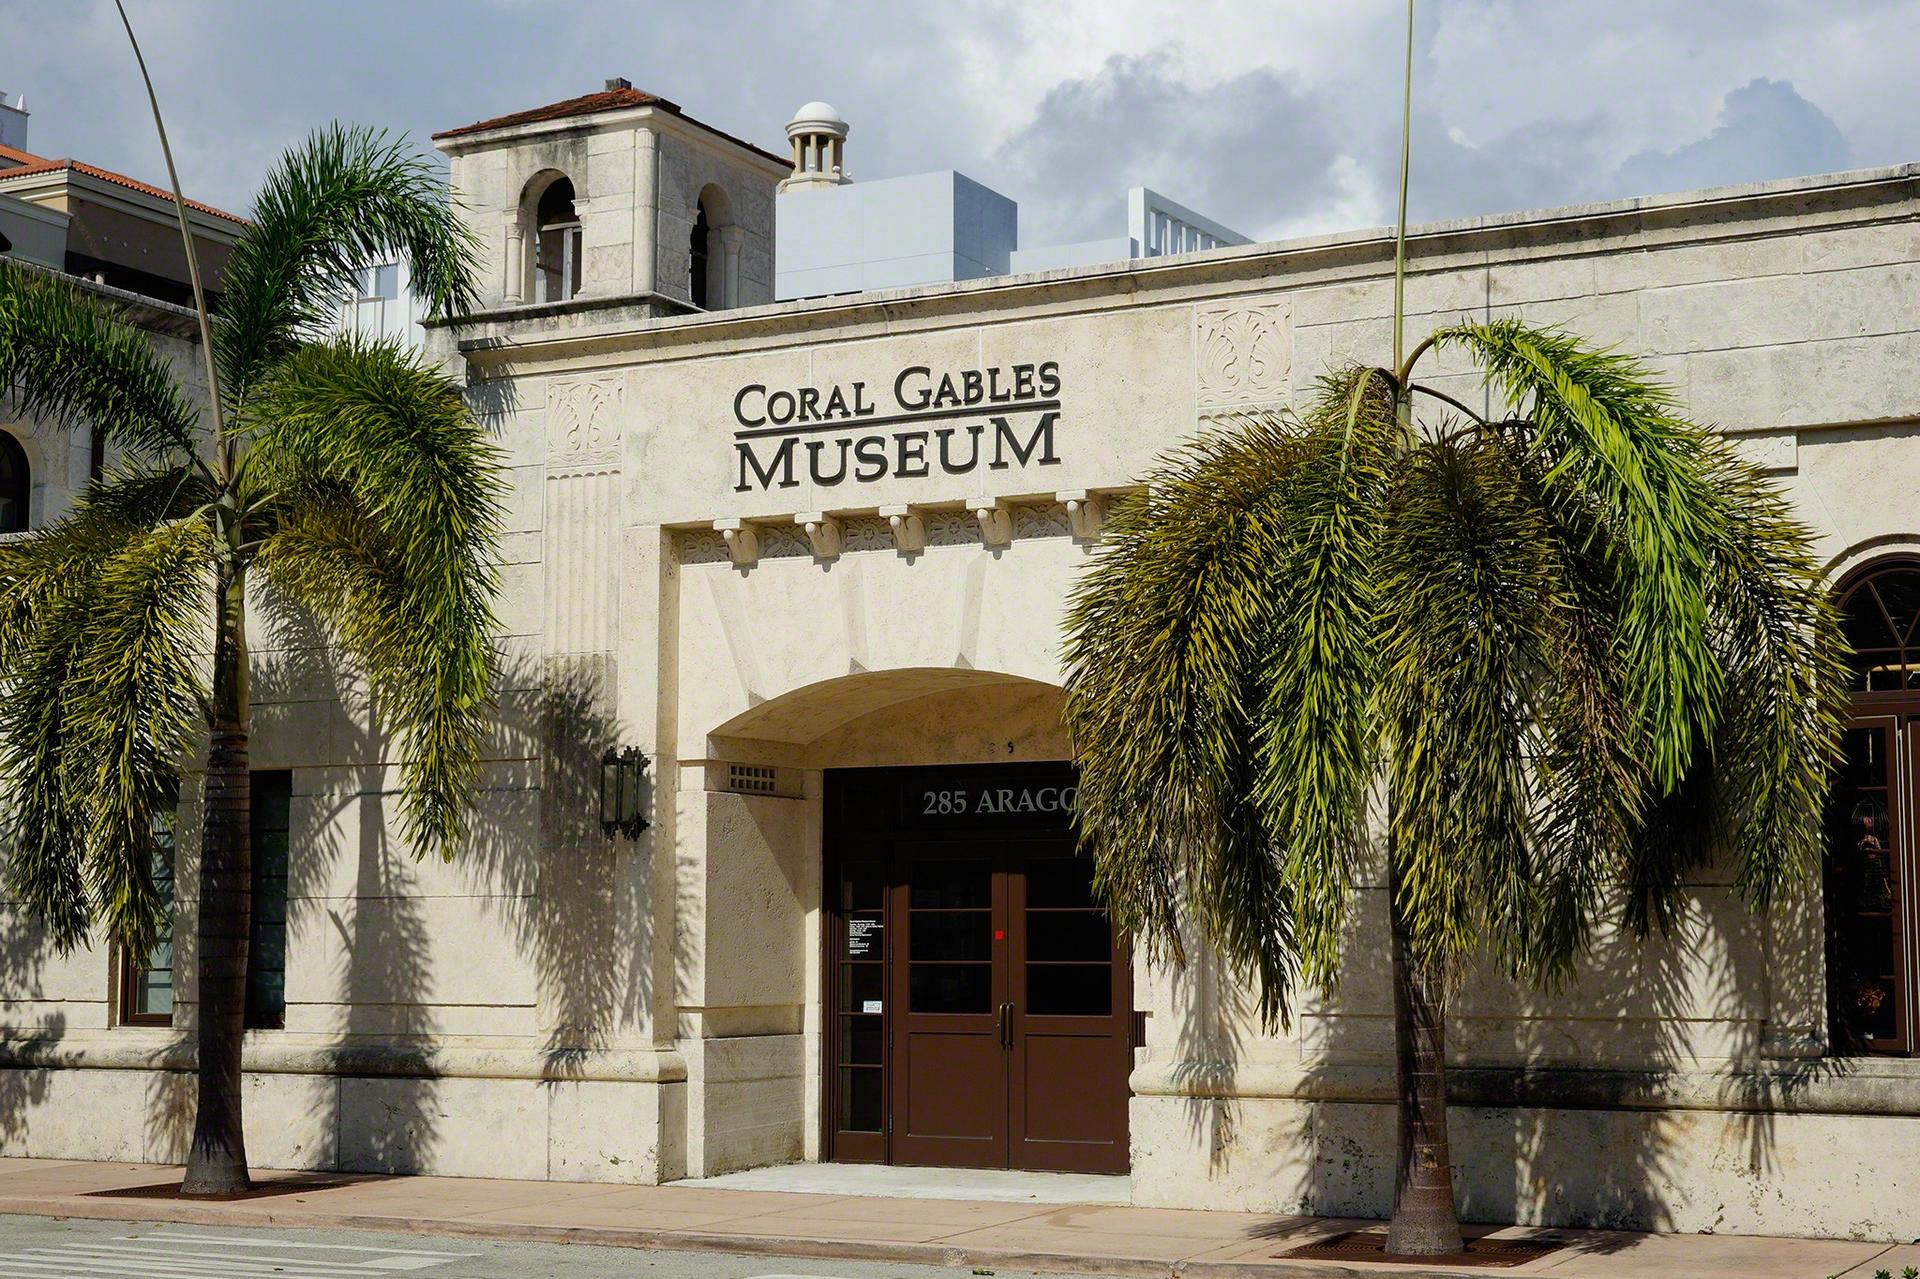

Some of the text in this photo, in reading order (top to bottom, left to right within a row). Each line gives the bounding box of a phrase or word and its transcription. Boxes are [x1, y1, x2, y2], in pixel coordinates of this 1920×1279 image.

[733, 361, 1061, 428] CORAL GABLES
[733, 412, 1061, 492] MUSEUM
[923, 790, 967, 815] 285
